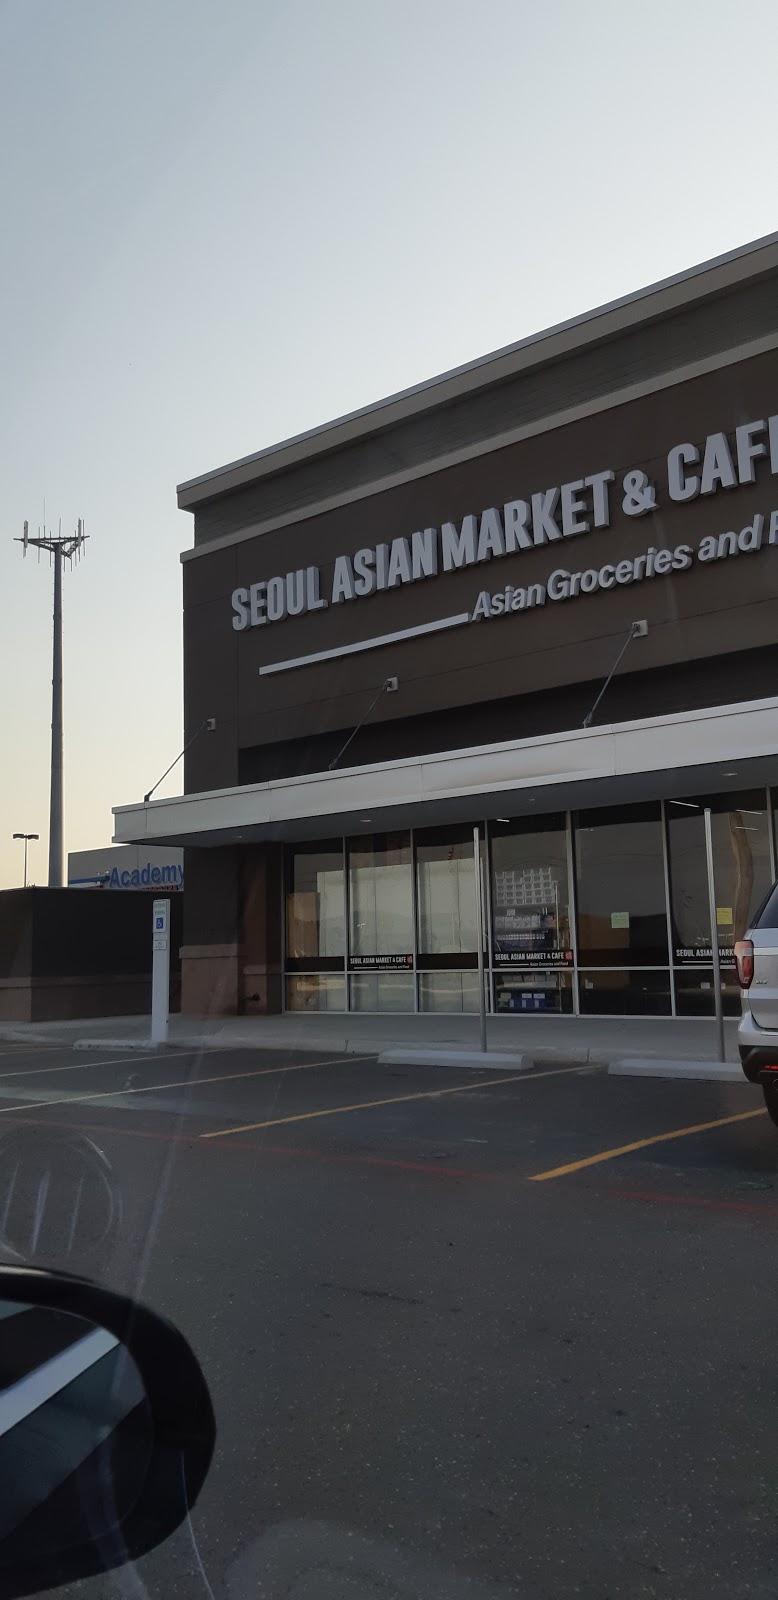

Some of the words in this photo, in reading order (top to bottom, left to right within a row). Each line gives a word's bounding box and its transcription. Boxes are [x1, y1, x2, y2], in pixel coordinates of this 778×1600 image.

[231, 566, 328, 631] SEOUL
[332, 527, 438, 603] ASIAN
[441, 470, 615, 572] MARKET
[622, 469, 660, 517] &
[472, 586, 546, 621] Asian
[547, 545, 693, 601] Groceries
[698, 514, 764, 564] and
[109, 862, 184, 888] Academy
[526, 952, 546, 960] MARKET
[676, 949, 695, 957] SEOUL
[696, 949, 713, 957] ASIAN
